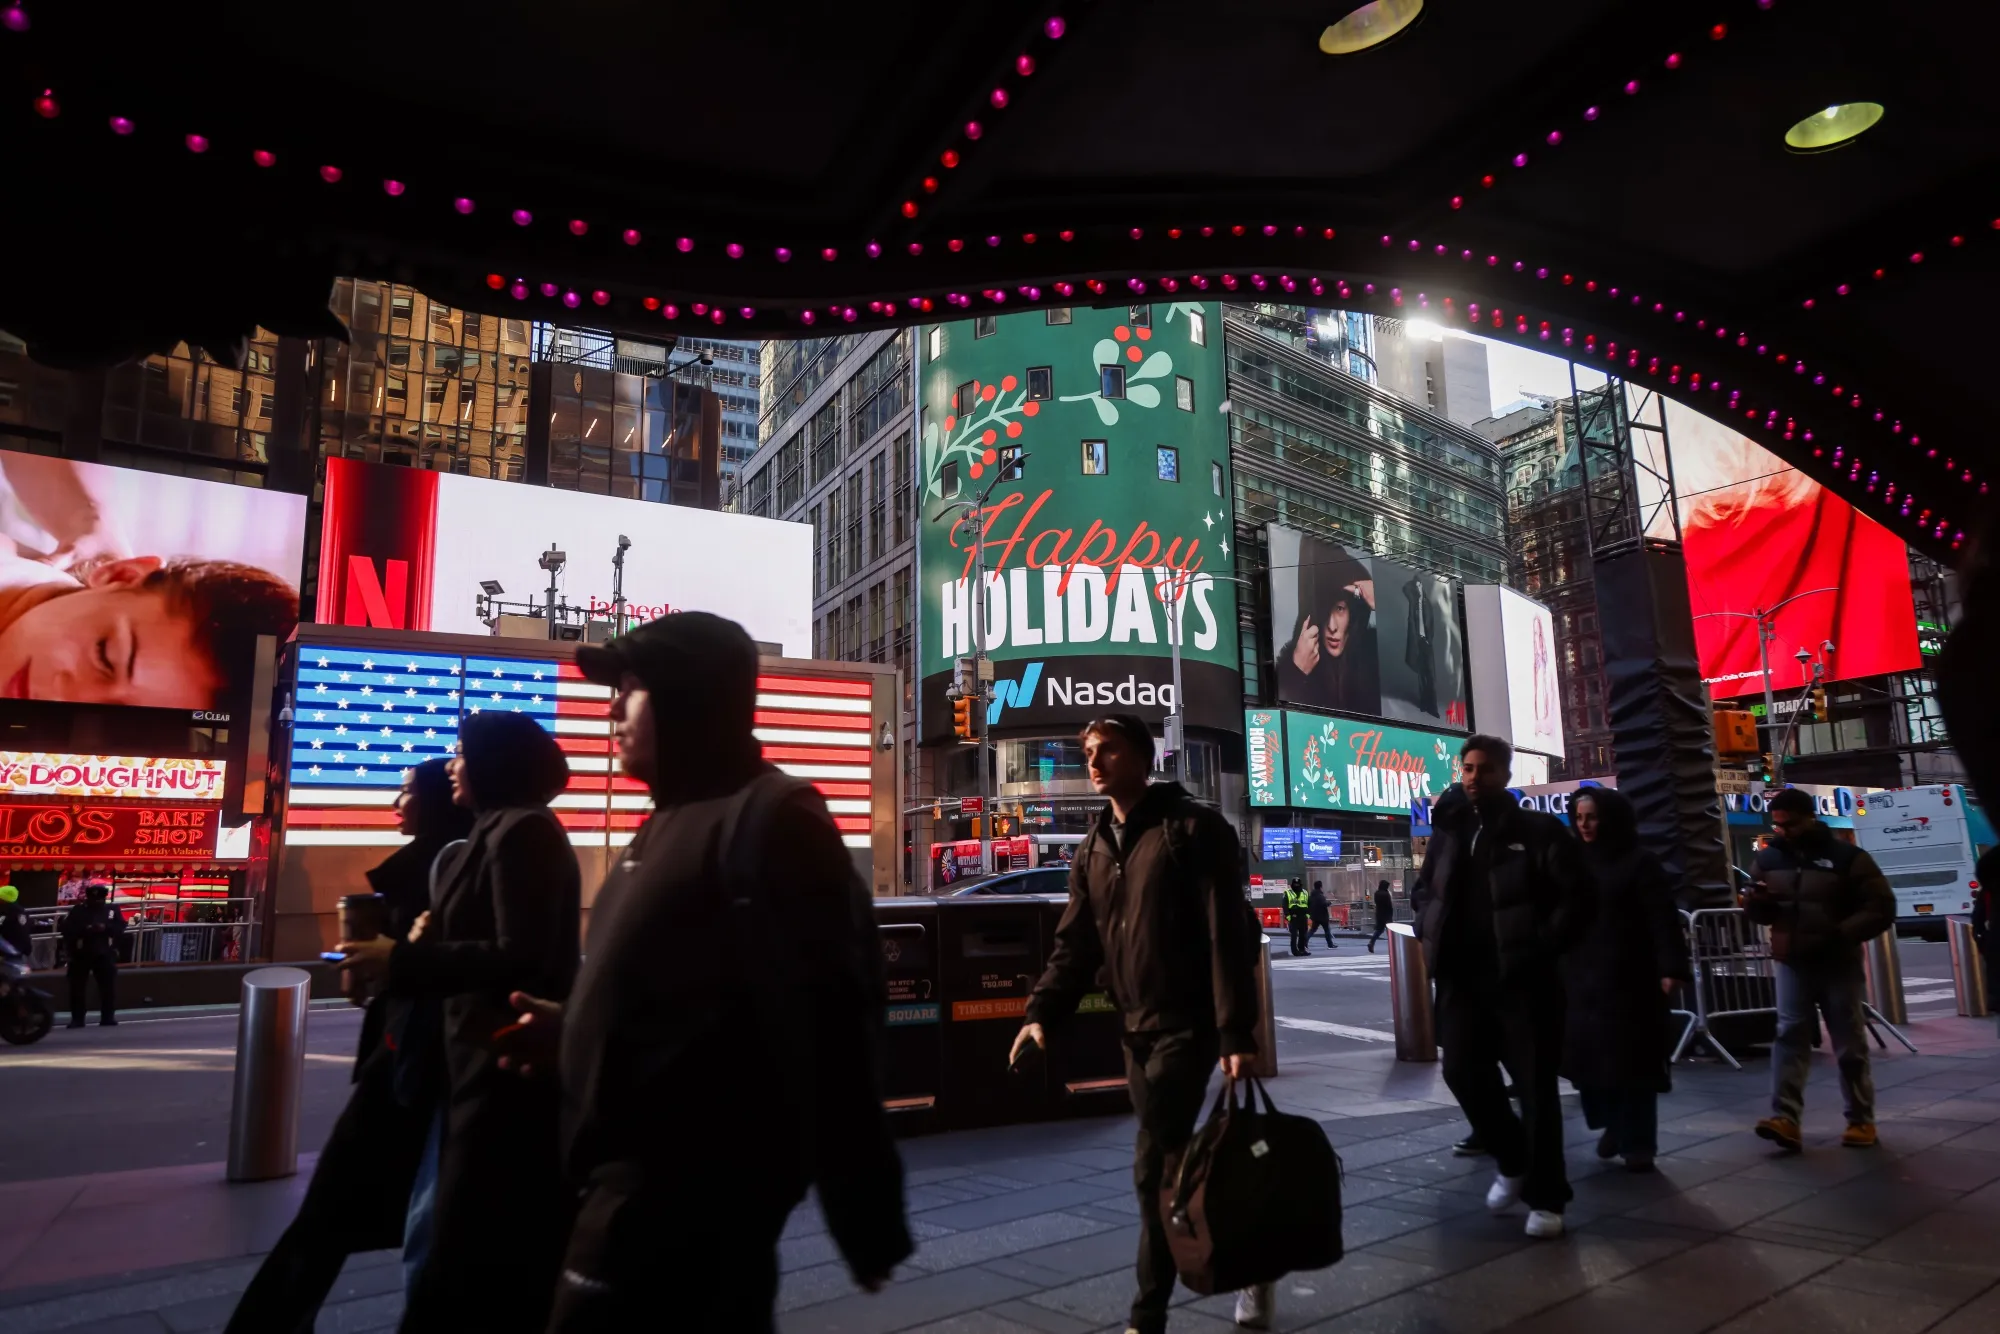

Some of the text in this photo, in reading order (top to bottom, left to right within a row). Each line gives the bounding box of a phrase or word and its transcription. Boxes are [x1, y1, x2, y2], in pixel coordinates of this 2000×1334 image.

[949, 489, 1204, 603] Happy
[942, 562, 1218, 659] HOLIDAYS
[1047, 675, 1176, 715] Nasdaq
[1250, 728, 1268, 787] HOLIDAYS
[1350, 729, 1426, 789] Happy
[29, 764, 221, 790] DOUGHNUT
[1505, 788, 1571, 814] OLICE
[138, 811, 205, 826] BAKE
[1, 845, 70, 855] SQUARE
[134, 830, 204, 844] SHOP
[138, 847, 170, 856] Buddy
[888, 1008, 937, 1022] SQUARE
[957, 1001, 1027, 1016] TIMES SQUA
